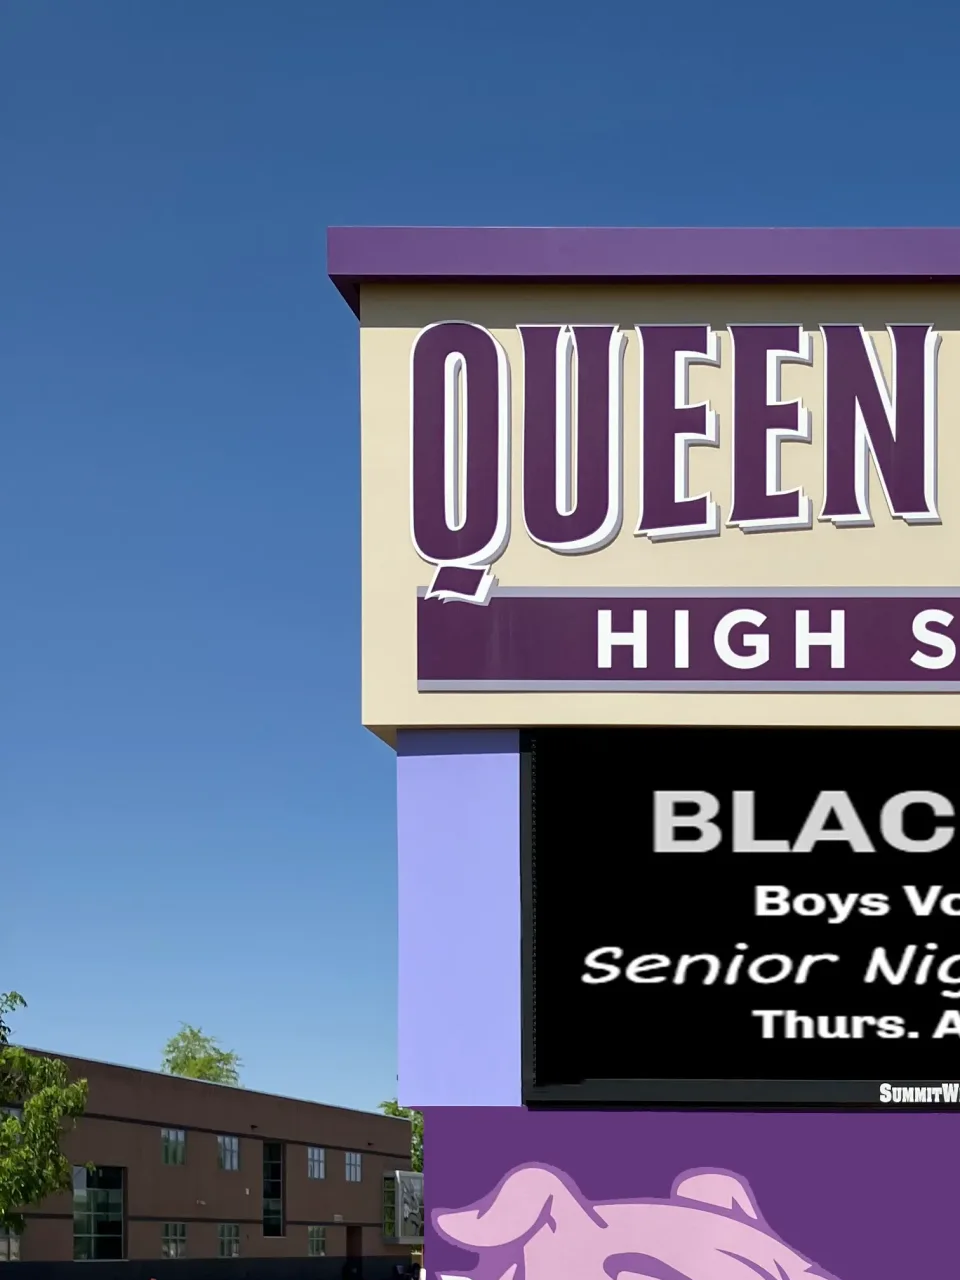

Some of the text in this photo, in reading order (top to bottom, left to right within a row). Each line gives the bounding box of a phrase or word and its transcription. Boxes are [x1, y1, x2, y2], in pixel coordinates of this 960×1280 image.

[410, 320, 942, 606] QUEEN
[597, 609, 846, 669] HIGH
[754, 885, 890, 924] Boys
[580, 942, 840, 985] Senior
[751, 1010, 920, 1039] Thurs.
